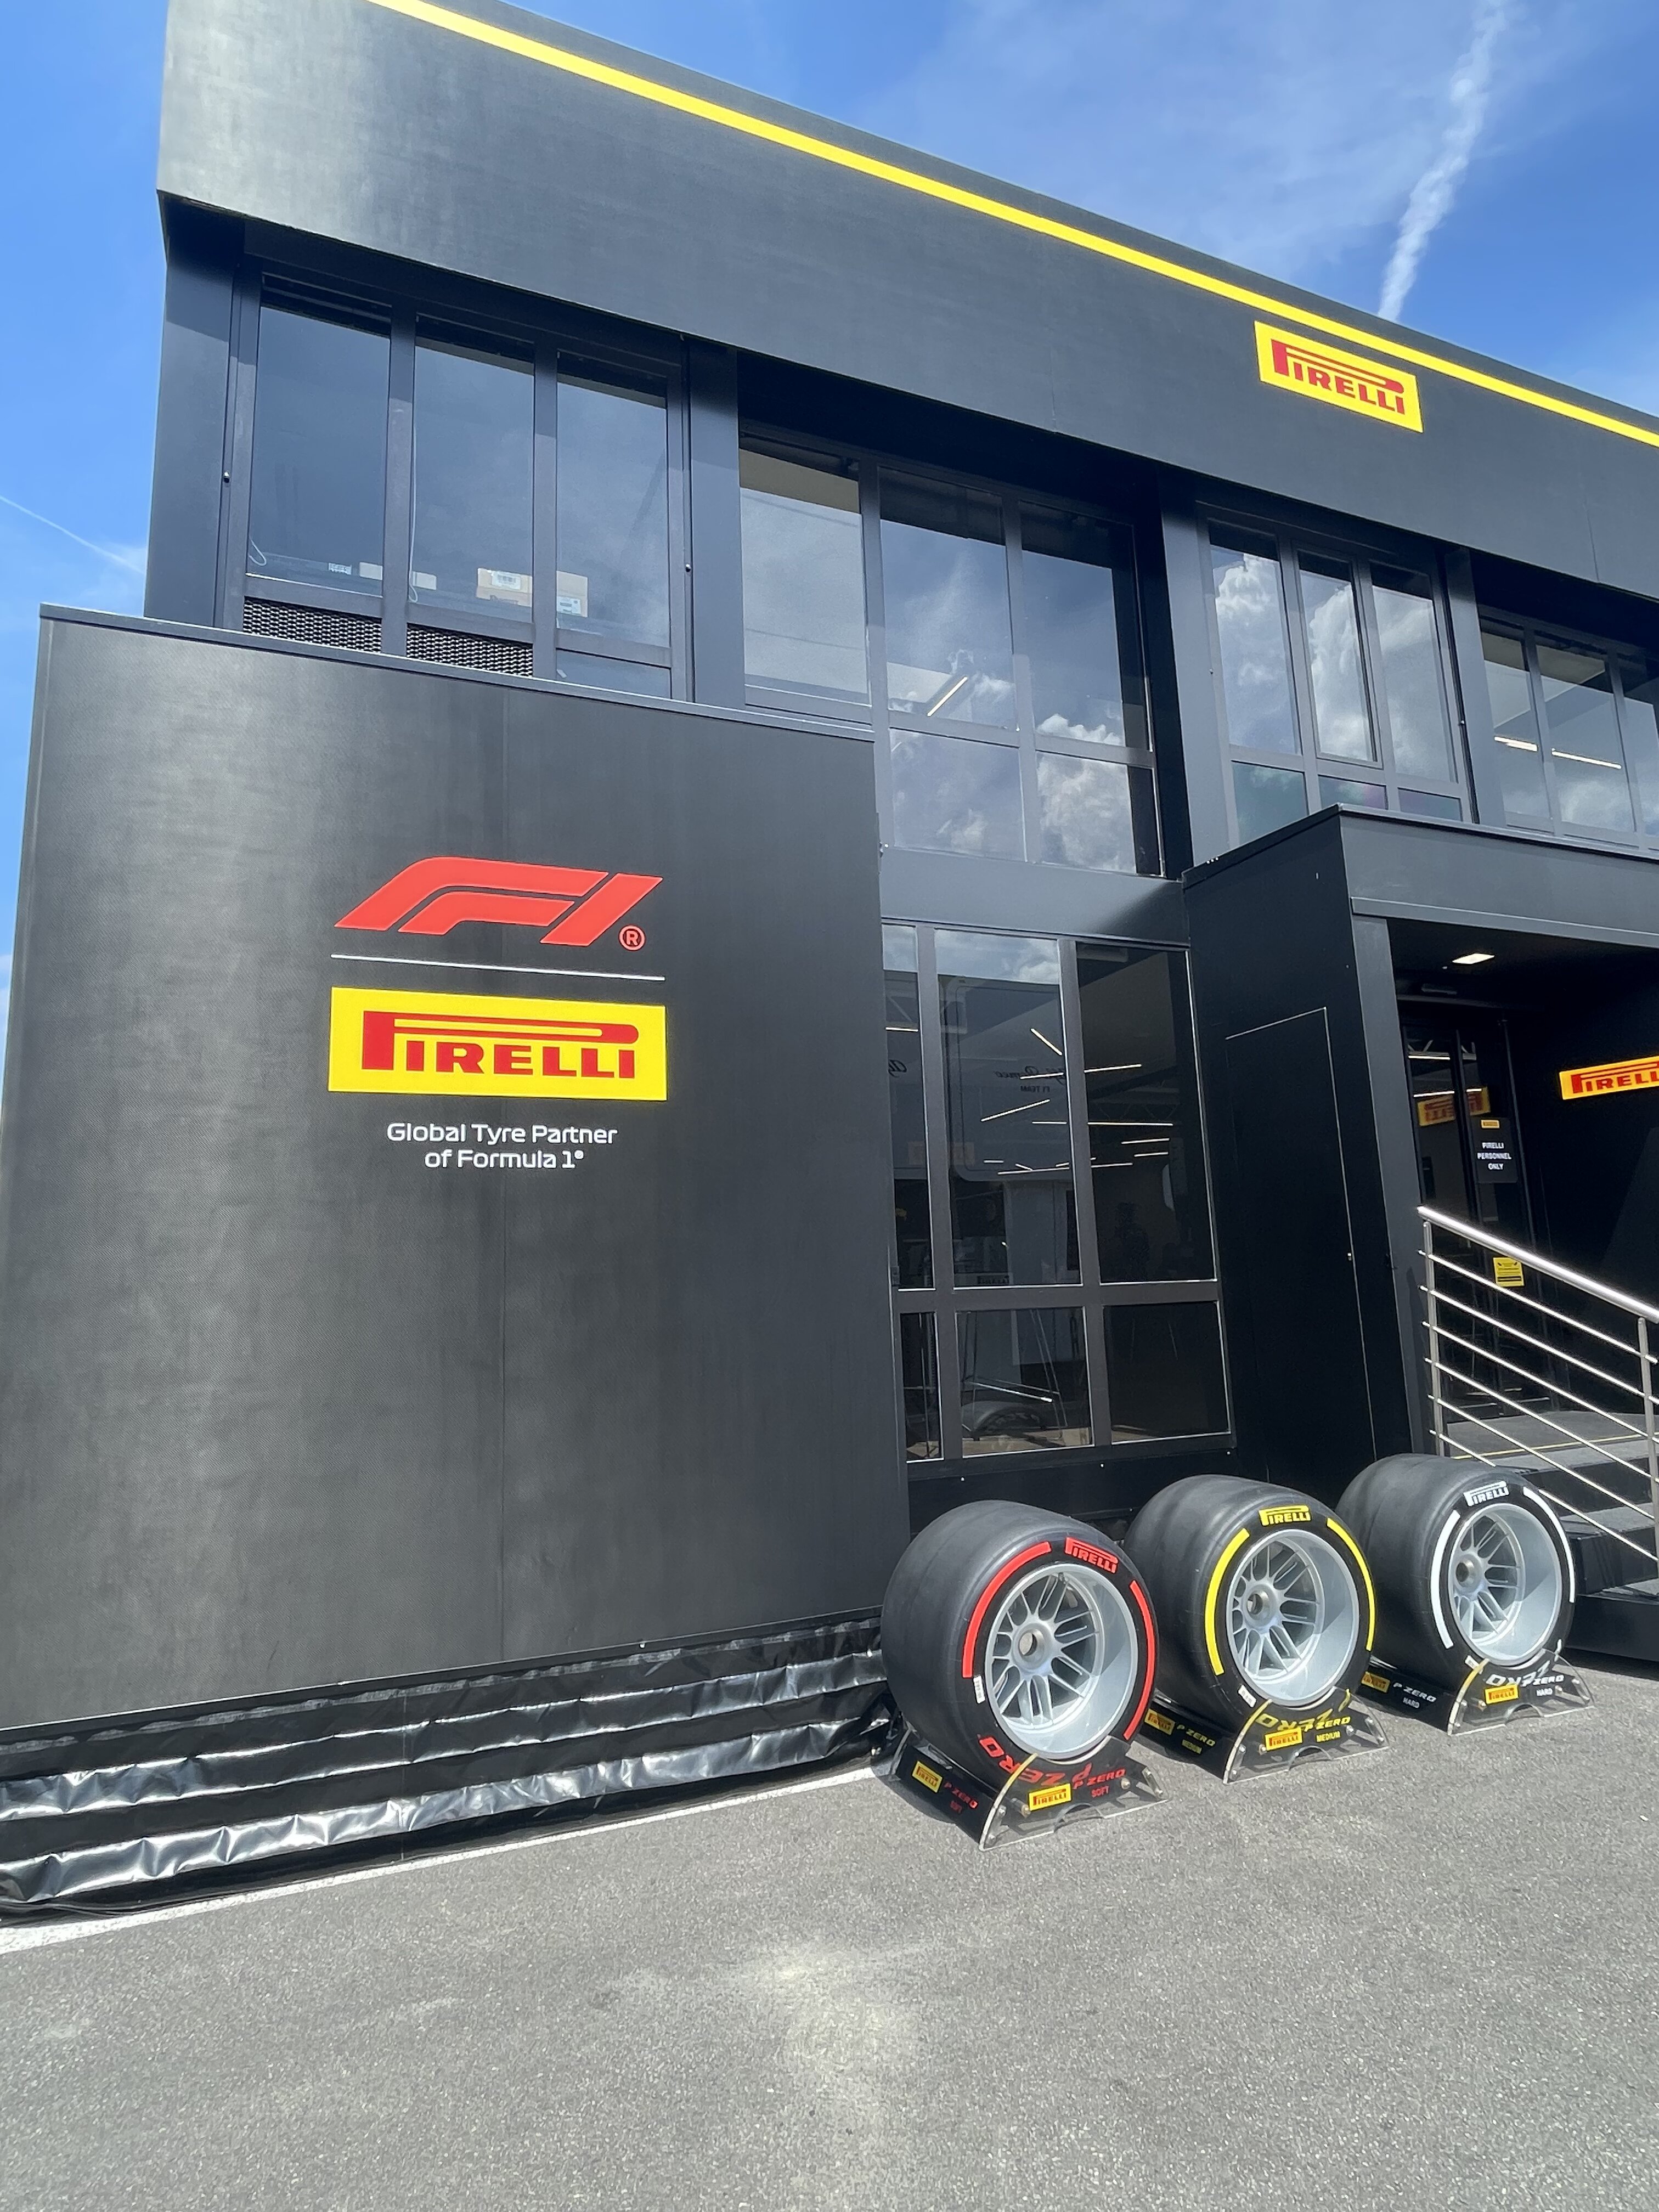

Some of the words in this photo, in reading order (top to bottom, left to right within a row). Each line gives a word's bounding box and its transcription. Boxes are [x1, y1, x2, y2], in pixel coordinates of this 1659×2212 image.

[1271, 338, 1405, 415] PIRELLI
[334, 855, 663, 946] F1
[362, 1010, 639, 1079] PIRELLI
[1571, 1061, 1659, 1094] PIRELL
[387, 1122, 466, 1142] Global
[471, 1124, 526, 1146] Tyre
[532, 1125, 618, 1144] Partner
[424, 1149, 453, 1169] of
[457, 1150, 557, 1169] Formula
[1463, 1481, 1510, 1507] PIRELLI
[1259, 1505, 1311, 1526] PIRELLI
[1064, 1537, 1119, 1574] PIRELLI
[1533, 1675, 1565, 1686] ZERO
[1488, 1688, 1515, 1701] PIRELLI
[1316, 1716, 1351, 1730] ZERO
[1186, 1729, 1216, 1747] ZERO
[1269, 1731, 1299, 1747] PIRELLI
[1317, 1730, 1341, 1742] MEDIUM
[916, 1765, 938, 1788] PIRELLI
[1087, 1769, 1126, 1786] ZERO
[1033, 1788, 1066, 1806] PIRELLI
[1091, 1785, 1110, 1798] SOFT
